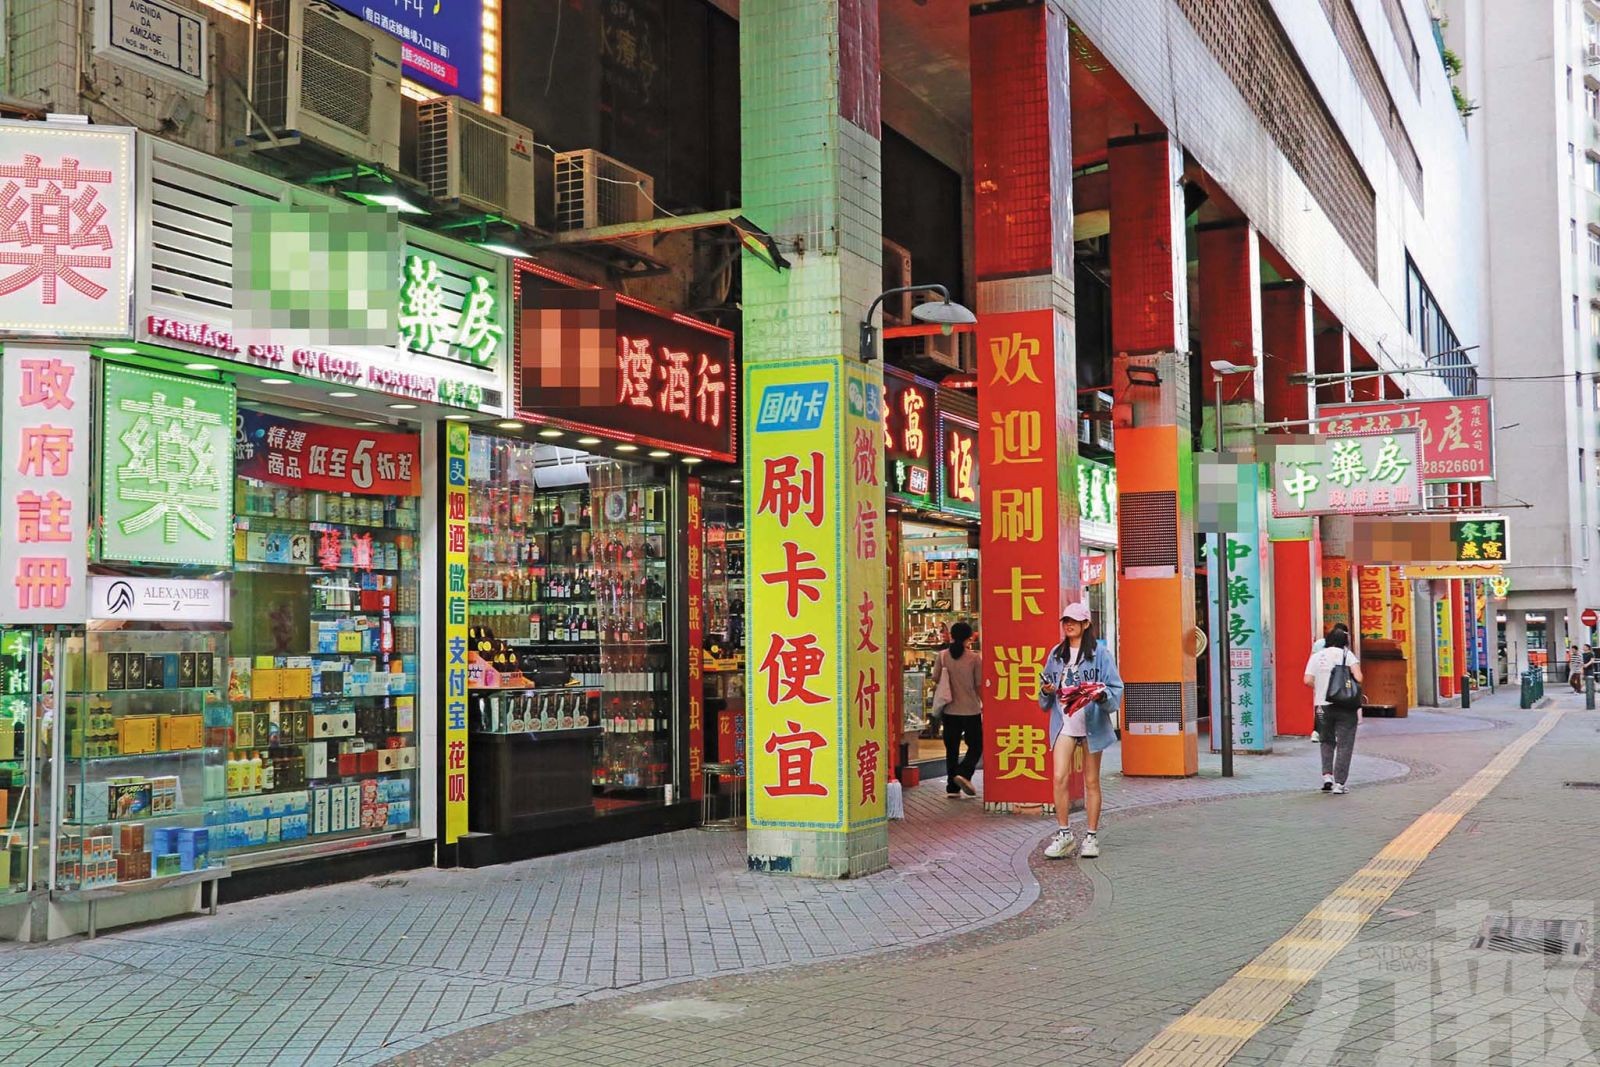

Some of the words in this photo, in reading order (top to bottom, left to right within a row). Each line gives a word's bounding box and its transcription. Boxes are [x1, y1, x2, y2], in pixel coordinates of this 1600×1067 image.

[129, 1, 162, 20] AVENIDA
[130, 25, 163, 45] AMIZADE
[140, 17, 151, 28] DA
[0, 152, 112, 304] 藥
[400, 255, 503, 363] 藥房
[148, 316, 240, 353] FARMACI
[292, 349, 318, 368] ON
[618, 335, 726, 427] 煙酒行
[760, 390, 824, 424] 国内卡
[1470, 405, 1483, 452] 有限公司
[267, 426, 306, 453] 精選
[308, 439, 413, 489] 低至5折起
[15, 357, 76, 611] 政府註冊
[118, 391, 223, 543] 藥
[268, 452, 303, 479] 商品
[1423, 458, 1485, 474] 28526601
[989, 331, 1048, 780] 欢迎刷卡消费
[144, 586, 210, 600] ALEXANDER
[172, 600, 181, 612] Z
[448, 562, 466, 625] 微信
[757, 452, 831, 798] 刷卡便宜
[448, 636, 467, 731] 支付宝
[448, 740, 467, 803] 花呗
